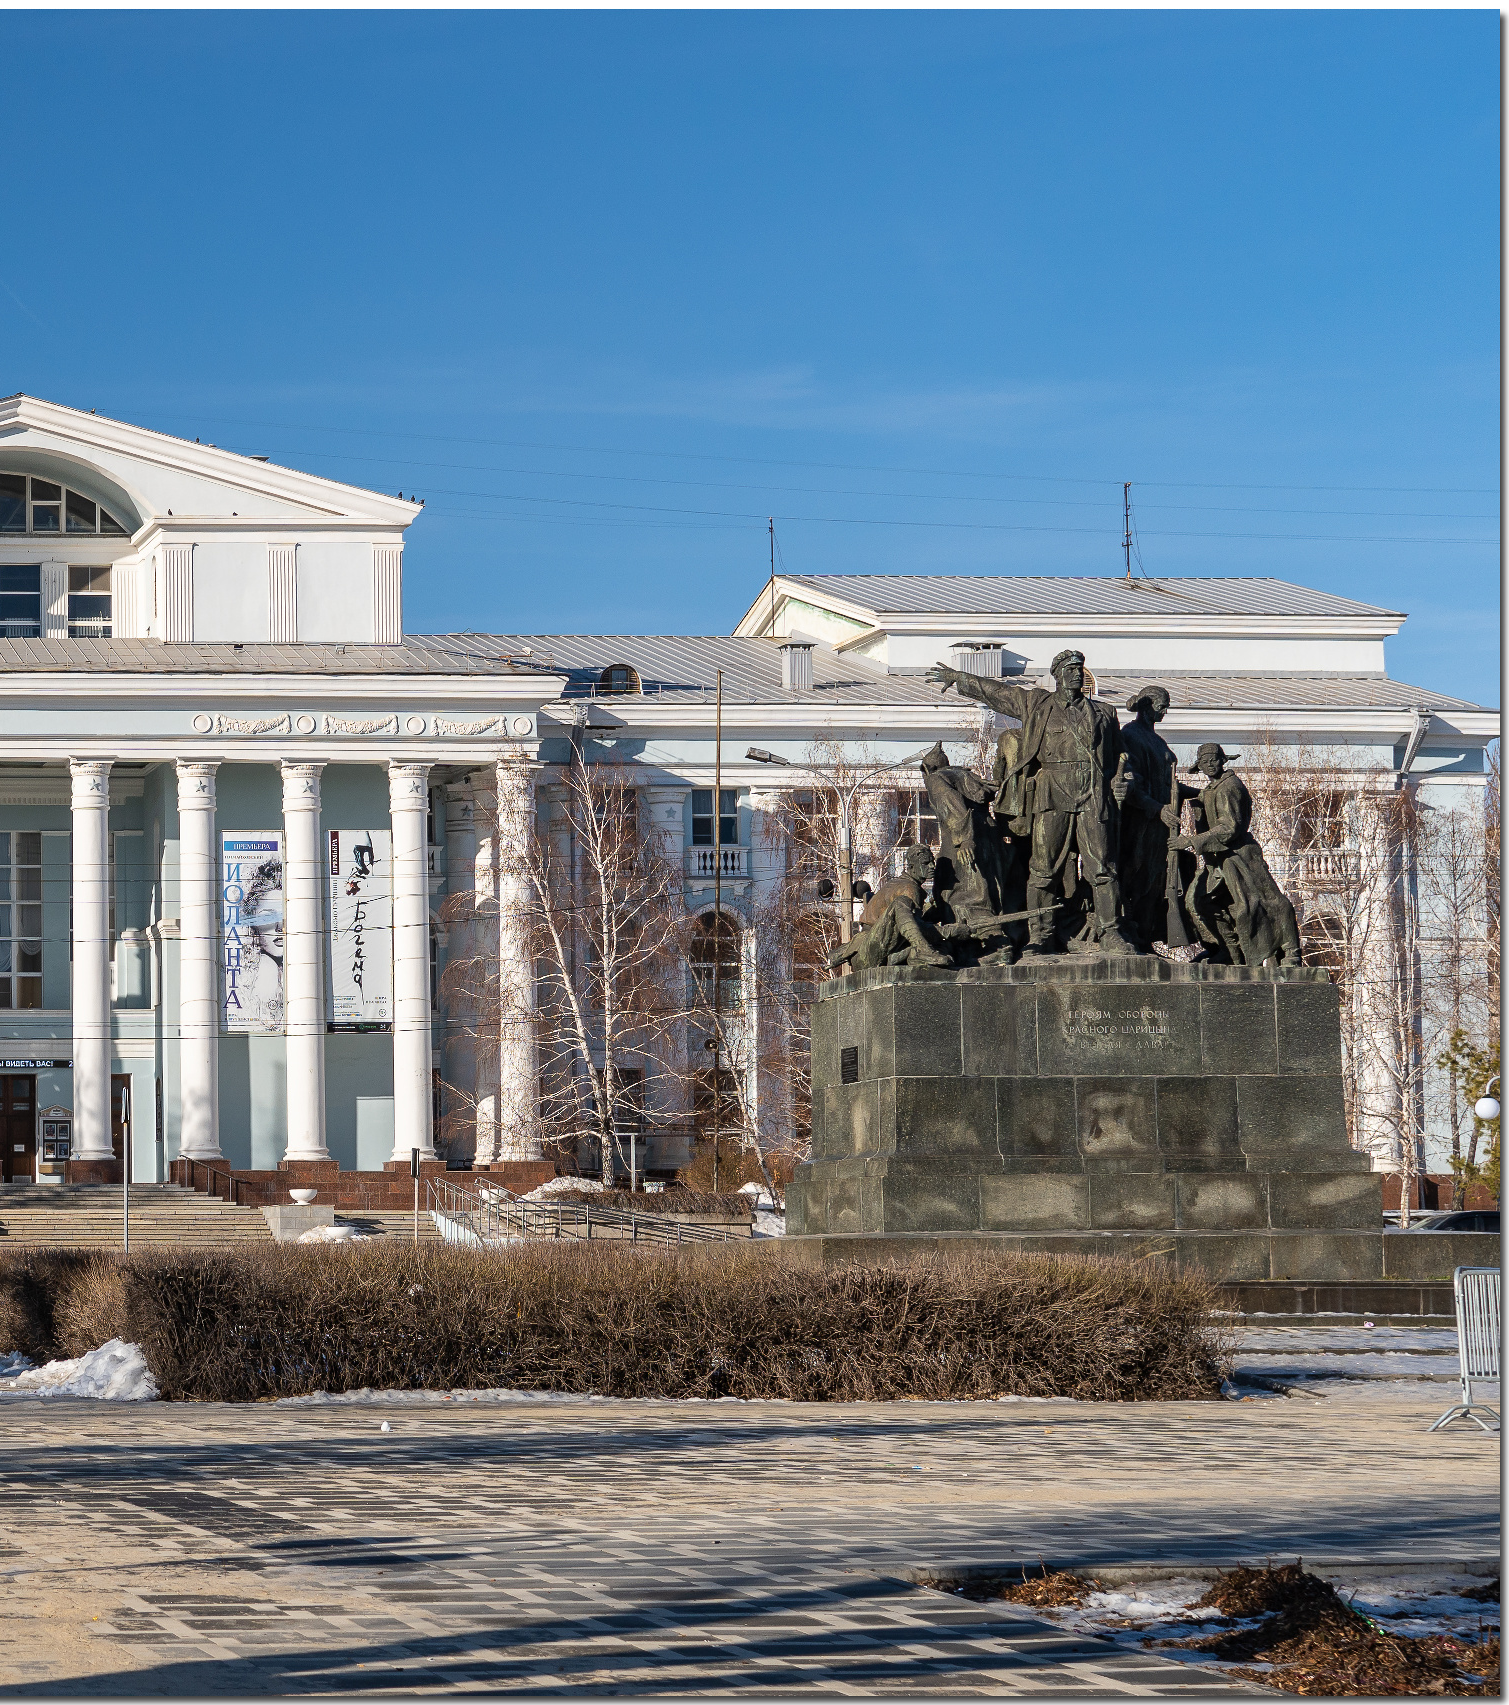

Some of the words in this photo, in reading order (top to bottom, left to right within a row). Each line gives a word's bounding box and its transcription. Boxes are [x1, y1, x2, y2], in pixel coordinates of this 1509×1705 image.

[223, 863, 244, 1008] ИОЛАНТА
[1068, 1010, 1111, 1019] ГЕРОЯМ
[1118, 1010, 1170, 1019] ОБОРОНЫ
[1062, 1025, 1118, 1034] КРАСНОГО
[1121, 1025, 1179, 1034] ЦАРИЦЫНА
